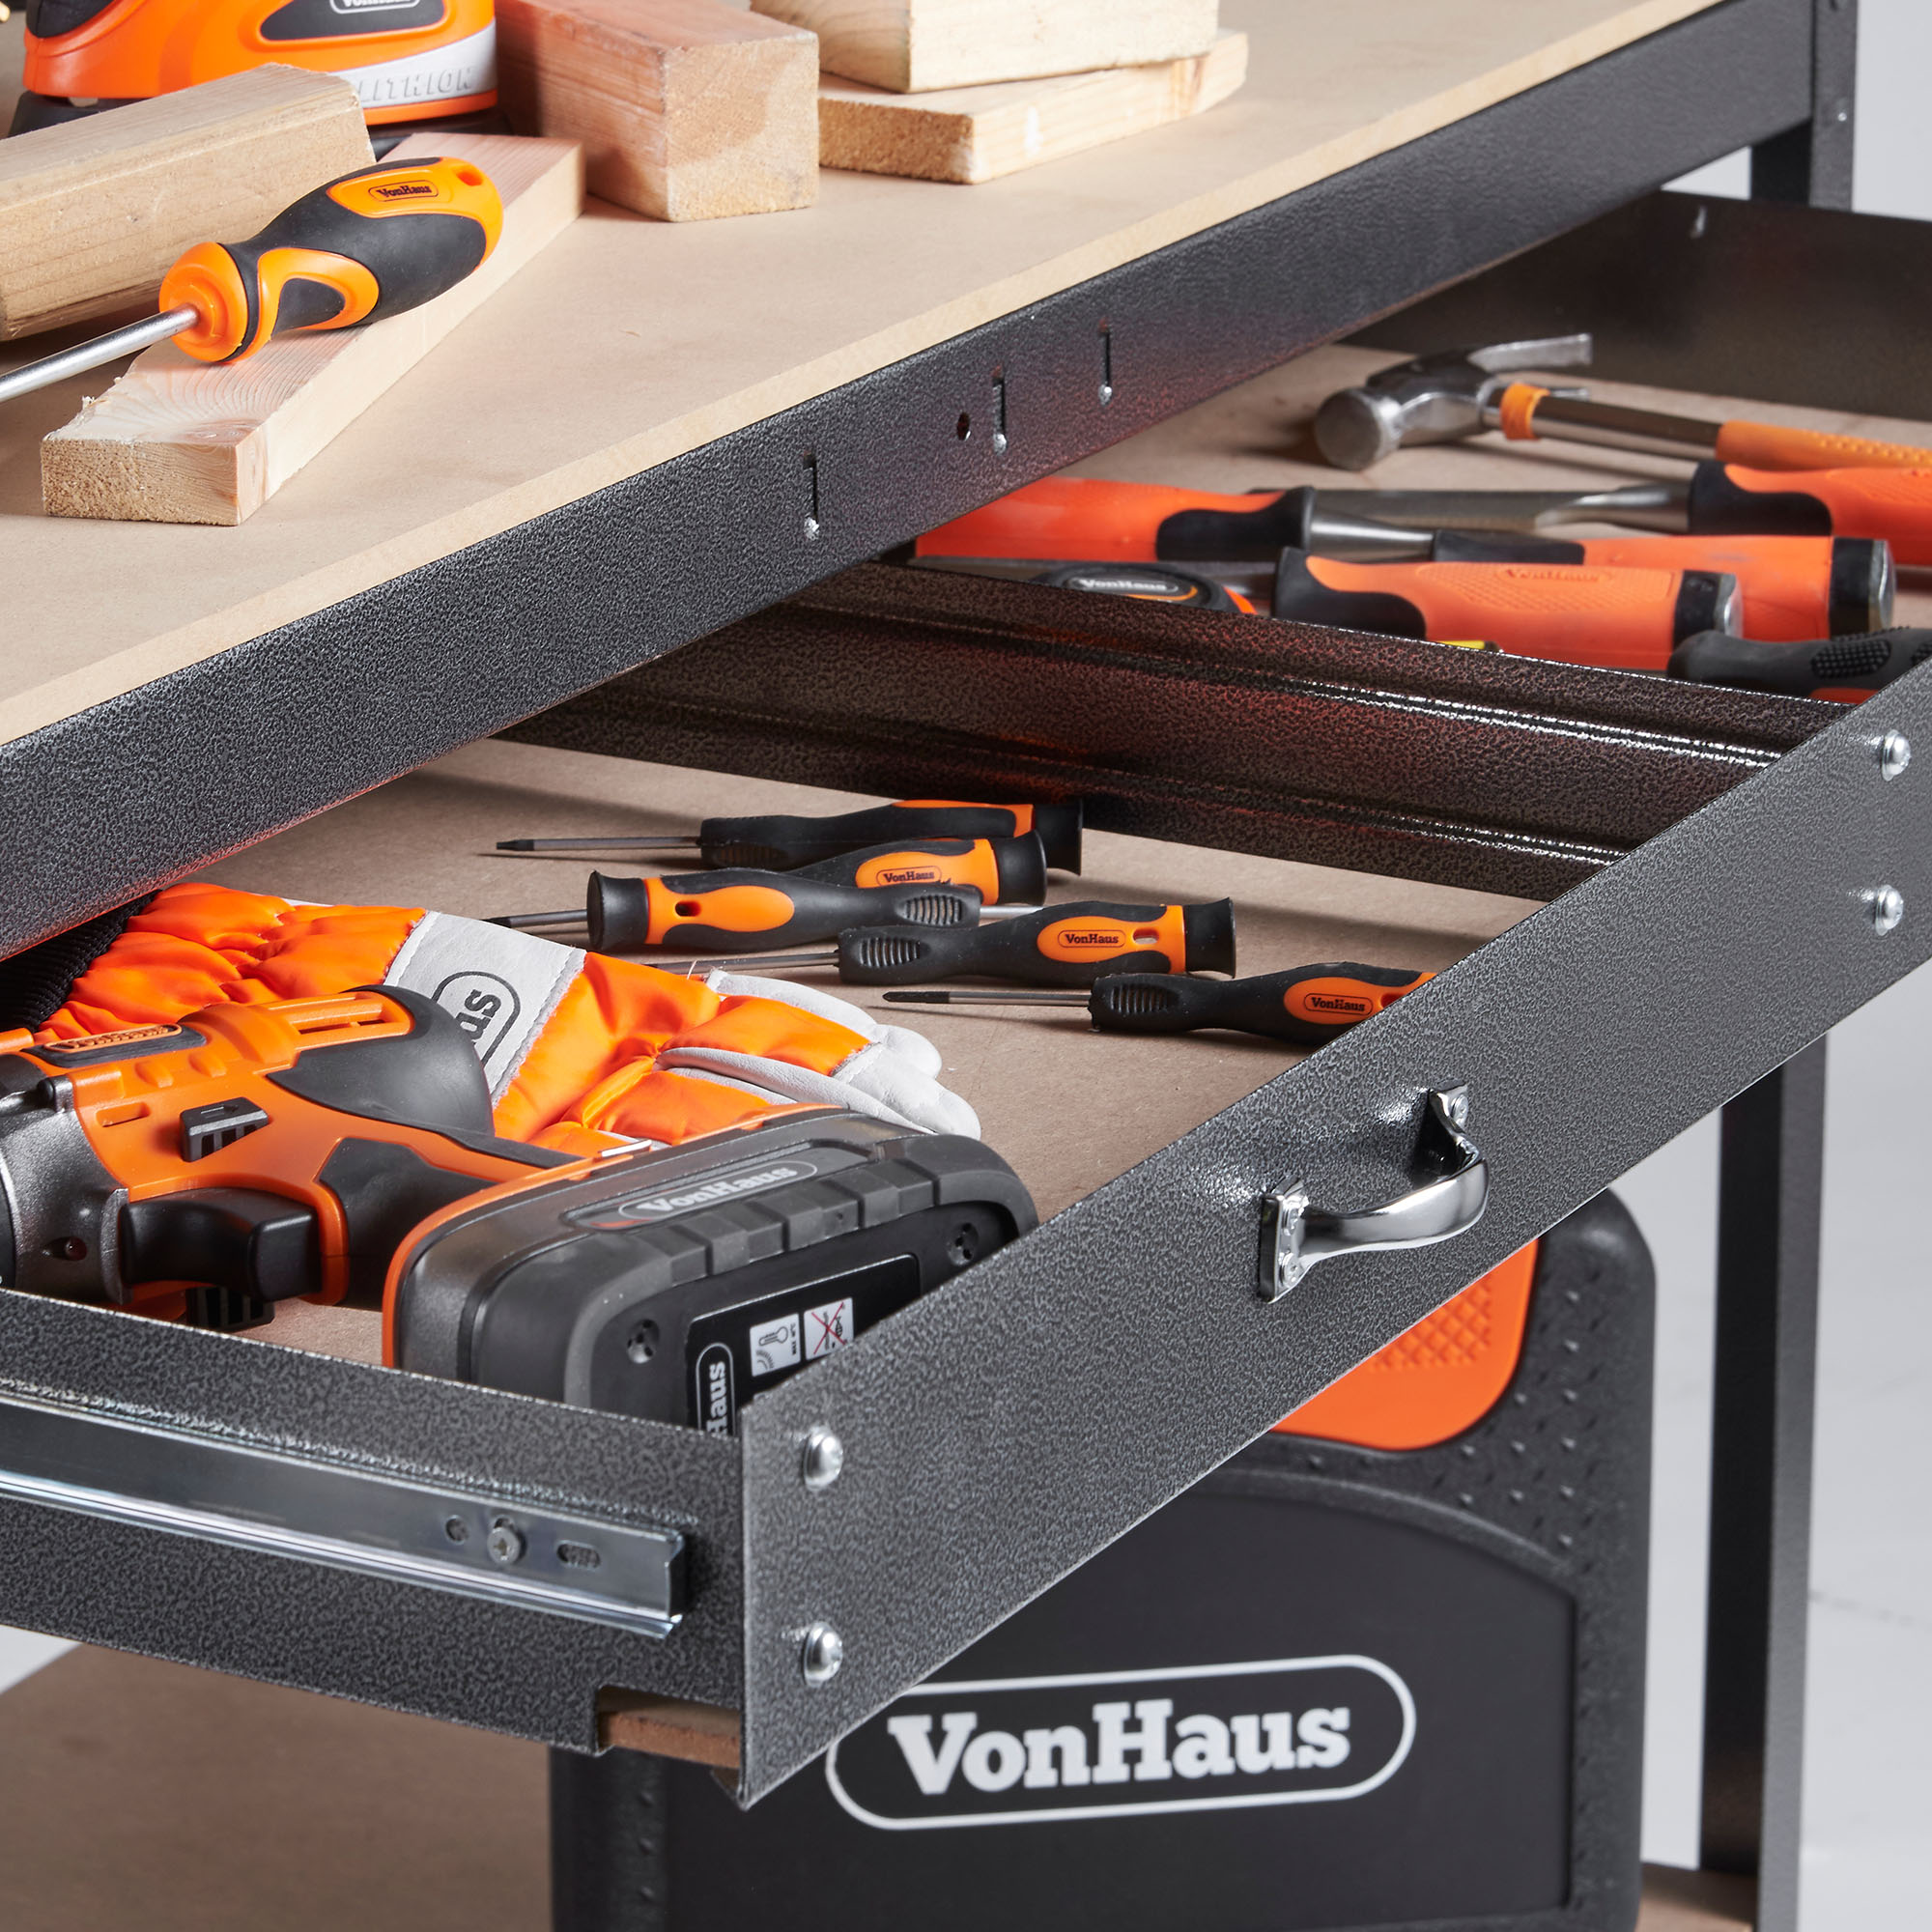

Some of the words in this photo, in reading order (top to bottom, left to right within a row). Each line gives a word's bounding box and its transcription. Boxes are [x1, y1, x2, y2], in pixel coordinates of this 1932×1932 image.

[376, 185, 433, 198] VonHaus
[1079, 579, 1167, 590] VonHaus
[883, 870, 935, 883] VonHaus
[1065, 933, 1119, 944] VonHaus
[1311, 997, 1366, 1011] VonHaus
[636, 1167, 798, 1212] VonHaus
[888, 1698, 1350, 1795] VonHaus
